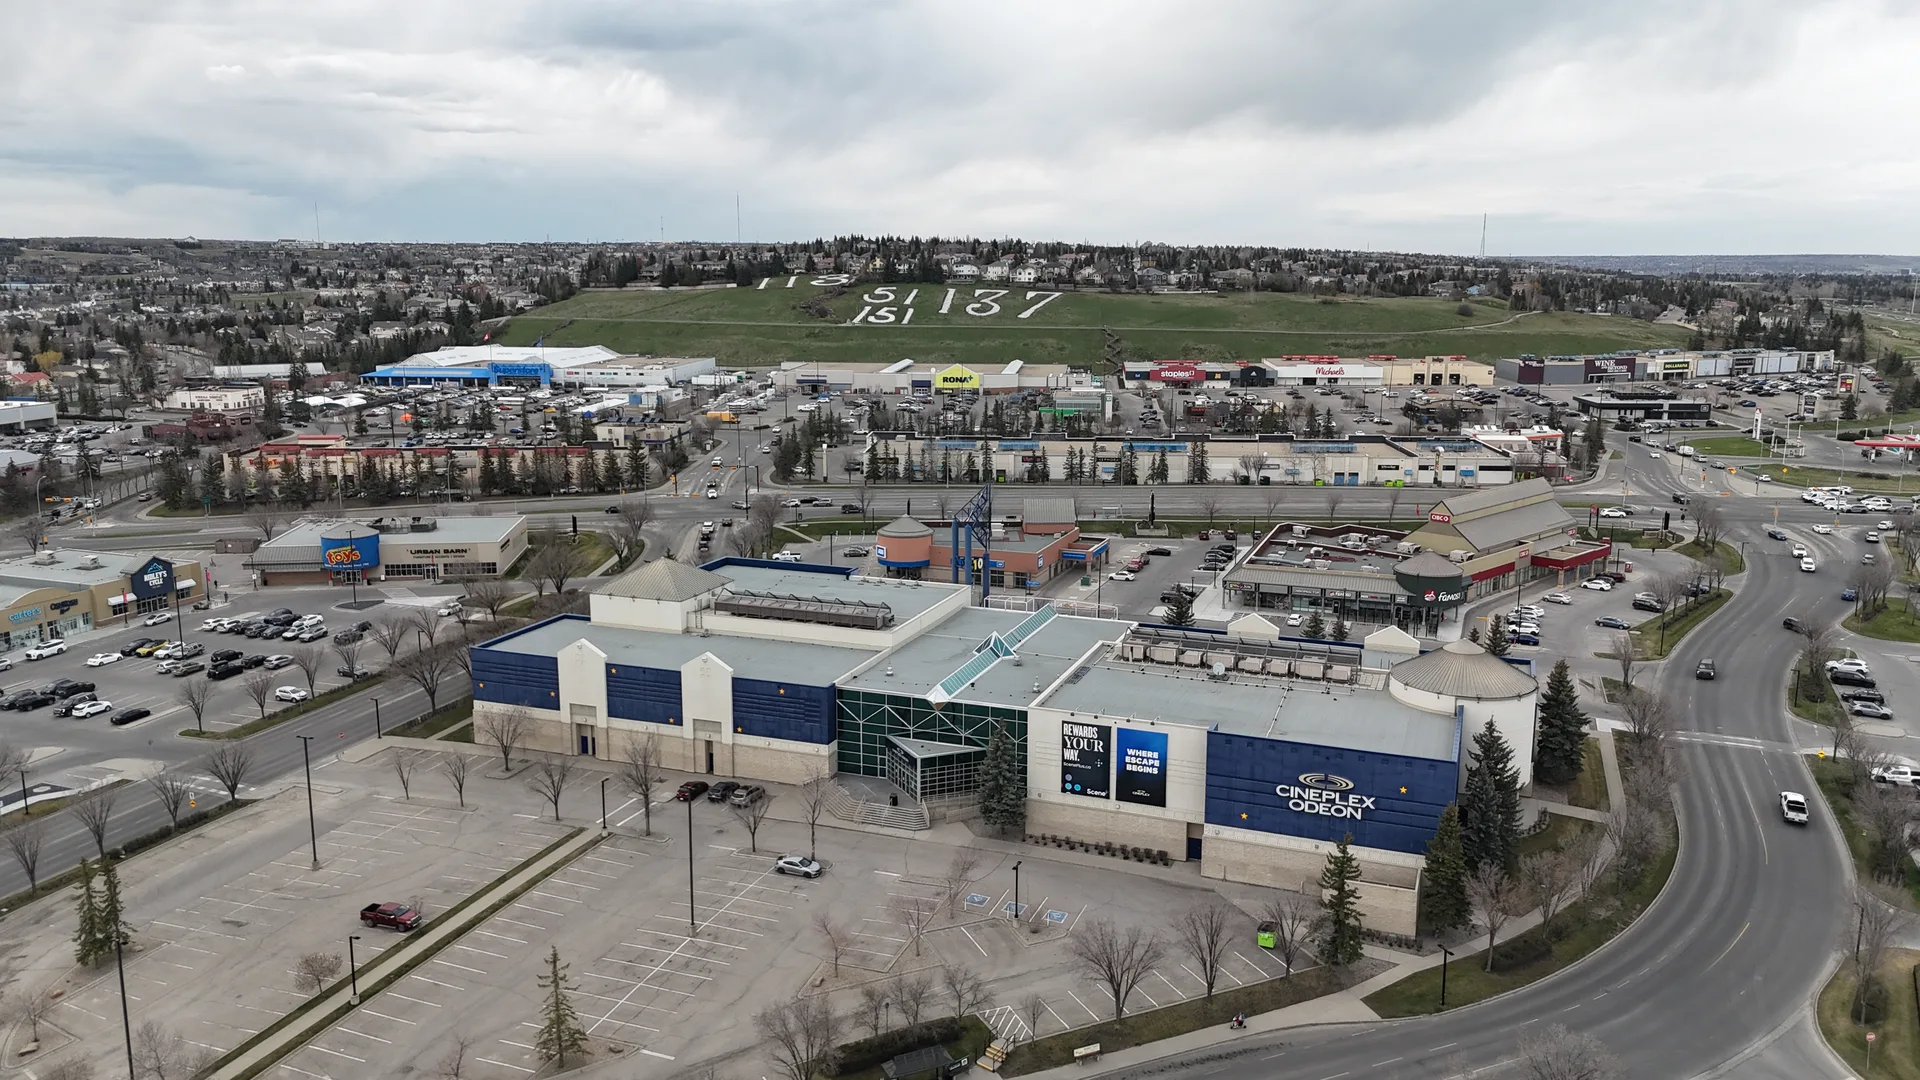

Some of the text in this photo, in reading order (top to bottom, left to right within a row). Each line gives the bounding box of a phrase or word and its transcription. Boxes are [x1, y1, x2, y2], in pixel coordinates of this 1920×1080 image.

[863, 287, 918, 304] 51
[938, 288, 1063, 318] 137
[852, 306, 914, 324] 151
[325, 549, 361, 565] toys
[9, 607, 41, 621] carter's
[1063, 723, 1098, 738] REWARDS
[1064, 736, 1104, 752] YOUR
[1063, 748, 1080, 761] WAY.
[1125, 756, 1160, 767] ESCAPE
[1126, 748, 1159, 759] WHERE
[1126, 763, 1159, 775] BEGINS
[1275, 784, 1376, 809] CINEPLEX
[1288, 799, 1362, 820] ODEON
